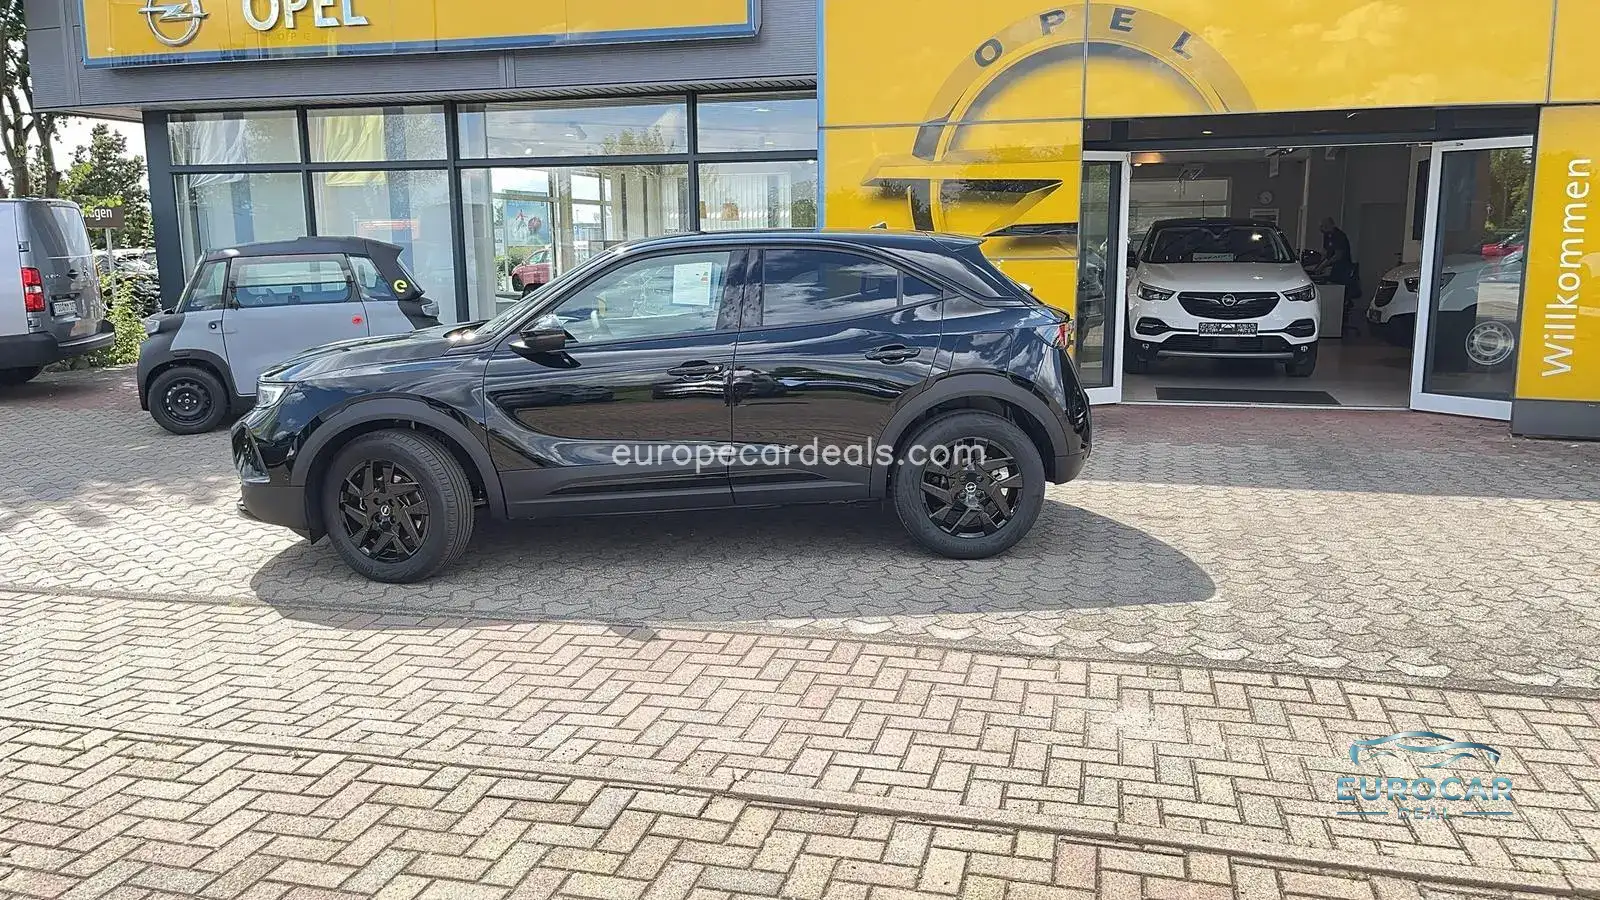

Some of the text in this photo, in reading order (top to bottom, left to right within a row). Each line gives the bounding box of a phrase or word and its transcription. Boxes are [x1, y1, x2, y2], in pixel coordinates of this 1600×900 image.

[242, 0, 369, 31] OPEL
[974, 7, 1193, 68] OPEL
[1541, 158, 1592, 376] Willkommen
